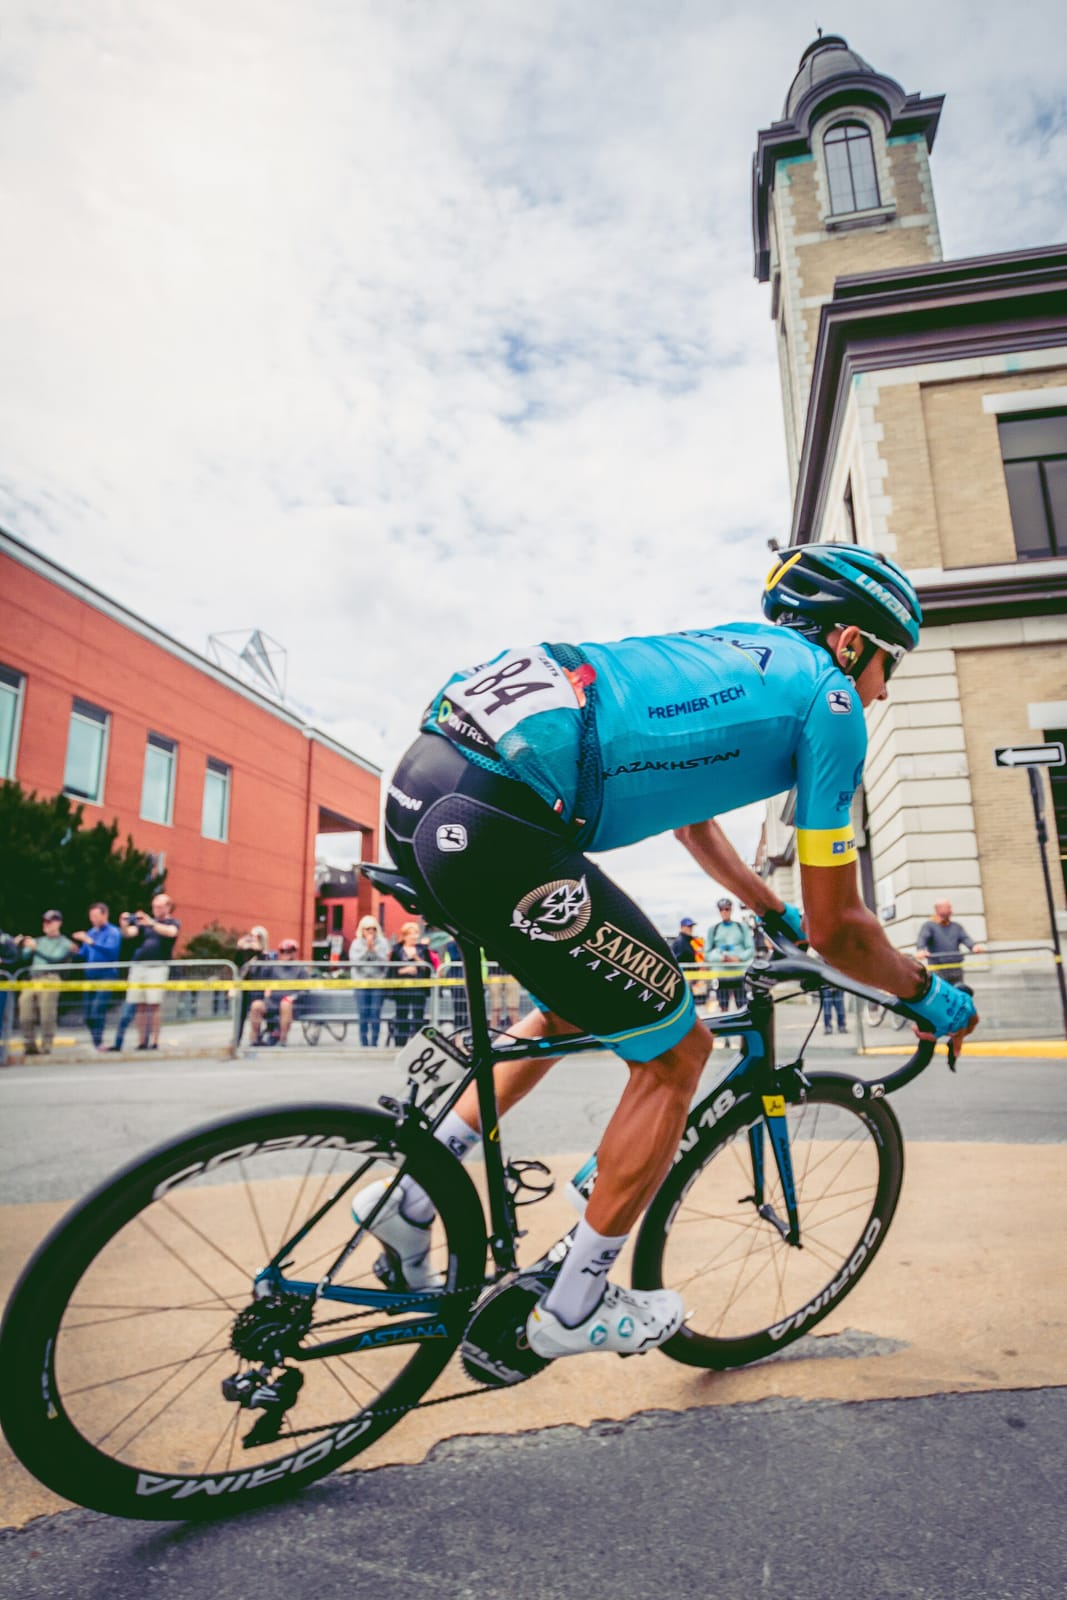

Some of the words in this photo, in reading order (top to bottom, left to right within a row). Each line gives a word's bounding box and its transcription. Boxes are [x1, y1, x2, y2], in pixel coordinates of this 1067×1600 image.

[464, 658, 555, 716] 84
[648, 696, 710, 719] PREMIER
[709, 684, 746, 706] TECH
[602, 749, 741, 780] KAZAKHSTAN
[568, 945, 667, 1013] KAZYNA
[586, 926, 681, 999] SAMRUK
[408, 1047, 448, 1084] 84
[699, 1089, 736, 1128] 18
[769, 1217, 882, 1341] CORIMA
[354, 1323, 448, 1352] ASTANA
[136, 1411, 373, 1499] CORIMA
